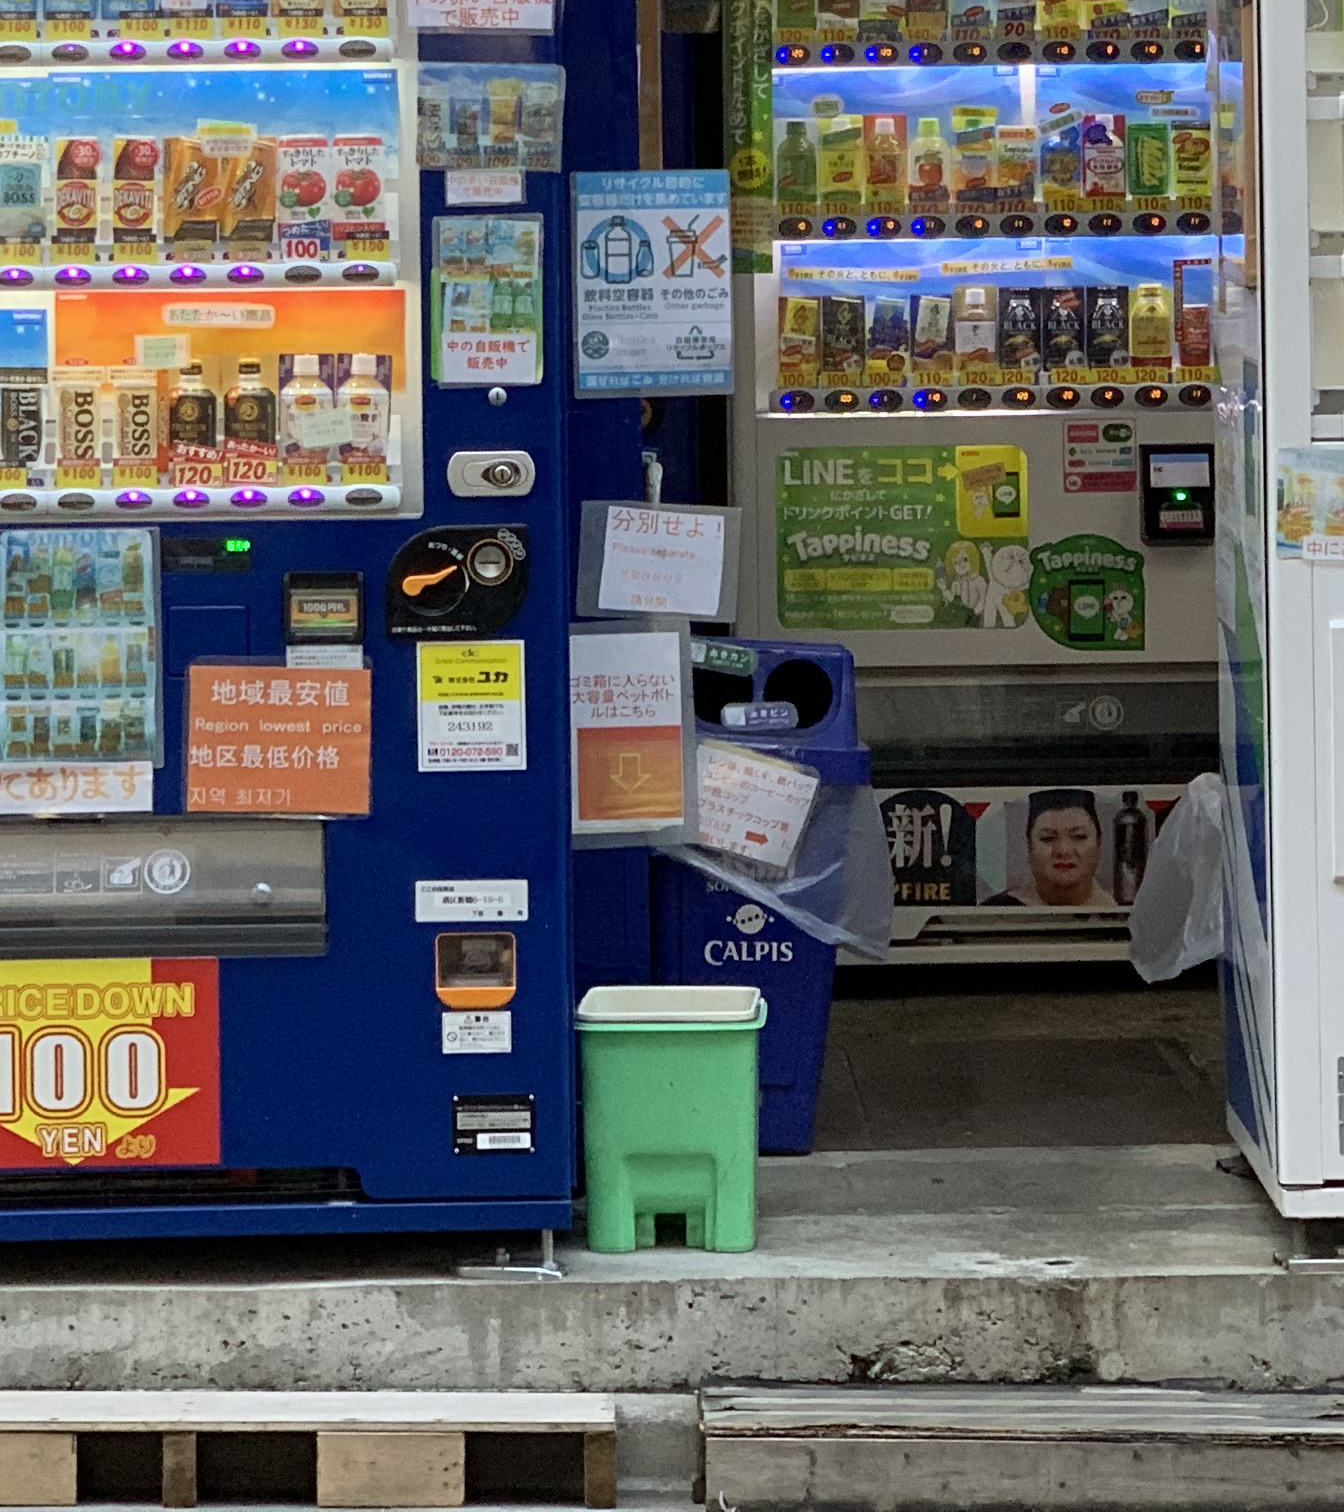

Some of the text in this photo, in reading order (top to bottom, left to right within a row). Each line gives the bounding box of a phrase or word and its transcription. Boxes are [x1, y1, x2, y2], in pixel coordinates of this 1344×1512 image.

[440, 7, 520, 28] で販売中
[446, 339, 531, 354] 中の自販機で
[466, 356, 508, 370] 販売中
[74, 390, 95, 459] BOSS
[786, 524, 931, 562] Tappiness
[1036, 546, 1140, 575] Tappiness
[210, 679, 351, 708] 地域最安値
[591, 705, 657, 719] ルはこちら
[194, 717, 363, 736] Region lowest price
[189, 743, 342, 770] 地区最低价格
[189, 787, 226, 806] 지역
[900, 883, 952, 901] FIRE
[703, 939, 794, 966] CALPIS
[75, 983, 197, 1018] DOWN
[38, 1122, 157, 1159] YEN より
